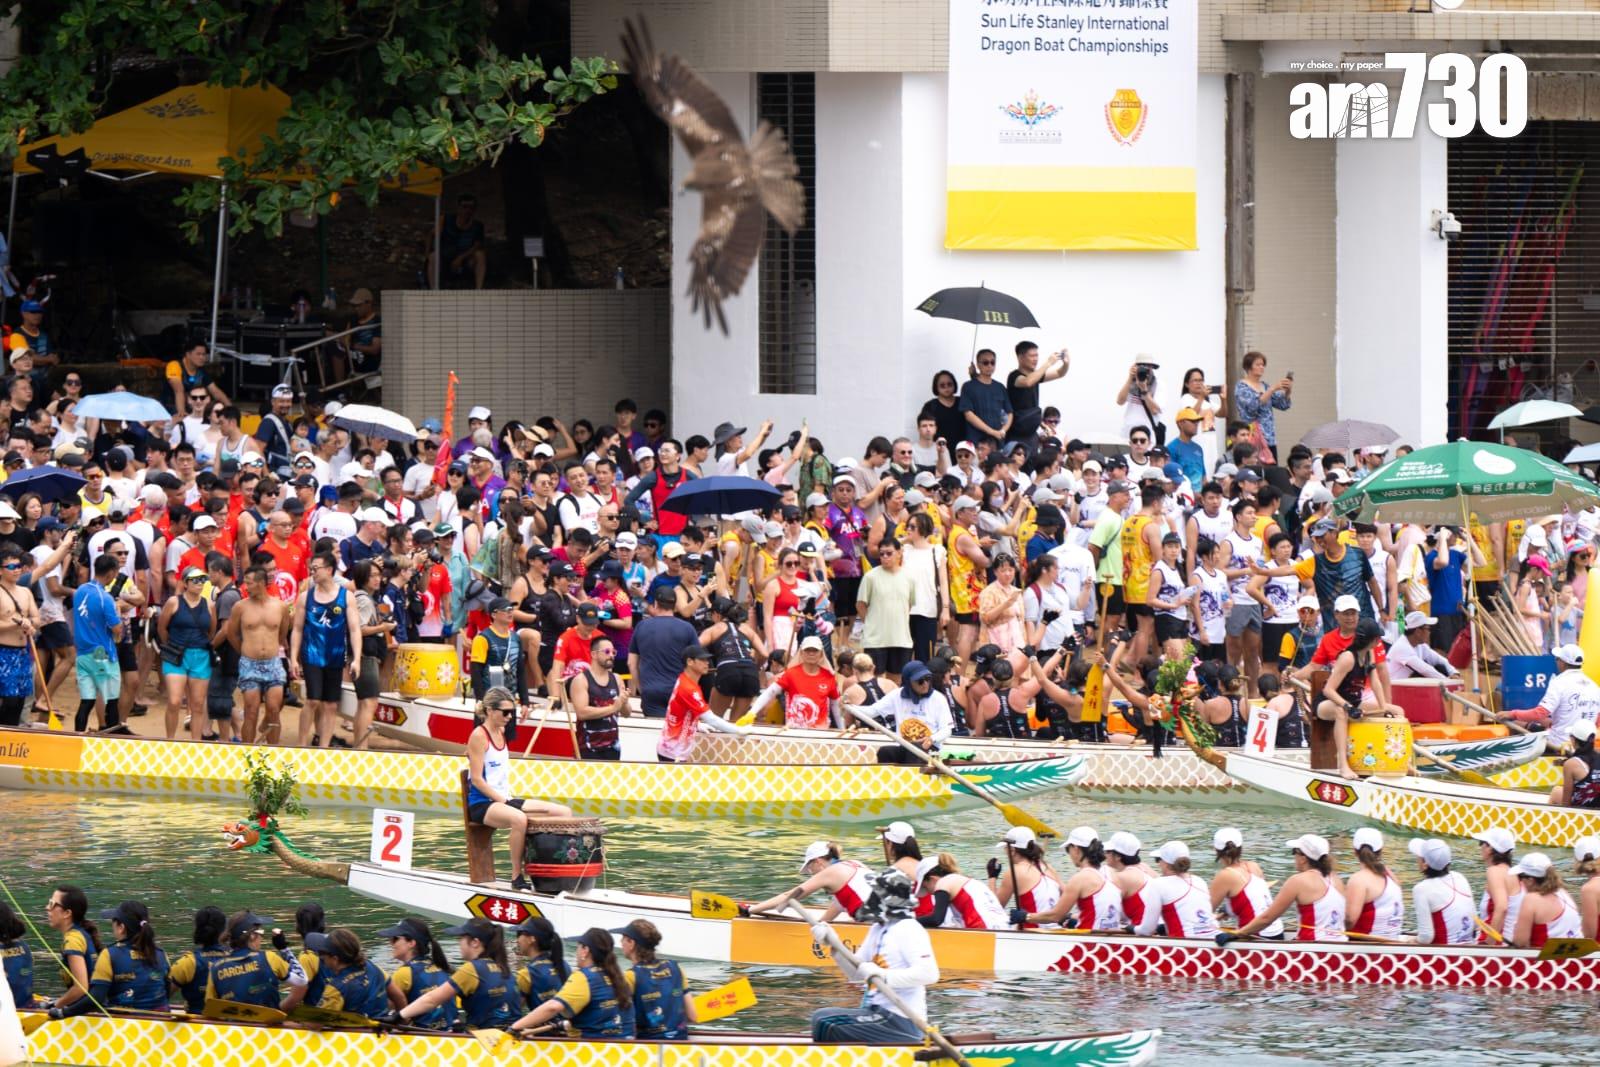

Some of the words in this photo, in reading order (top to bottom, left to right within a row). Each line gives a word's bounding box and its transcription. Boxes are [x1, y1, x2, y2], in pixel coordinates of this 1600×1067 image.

[981, 13, 1007, 28] Sun
[1009, 13, 1034, 29] Life
[1037, 14, 1085, 32] Stanley
[1087, 15, 1169, 31] International
[981, 36, 1030, 55] Dragon
[1034, 37, 1065, 52] Boat
[1068, 37, 1169, 56] Championships
[983, 310, 1011, 324] IBI
[1252, 720, 1268, 753] 4
[8, 742, 30, 758] Life
[381, 824, 403, 863] 2
[490, 900, 520, 921] 赤柱
[217, 960, 260, 981] CAROLINE
